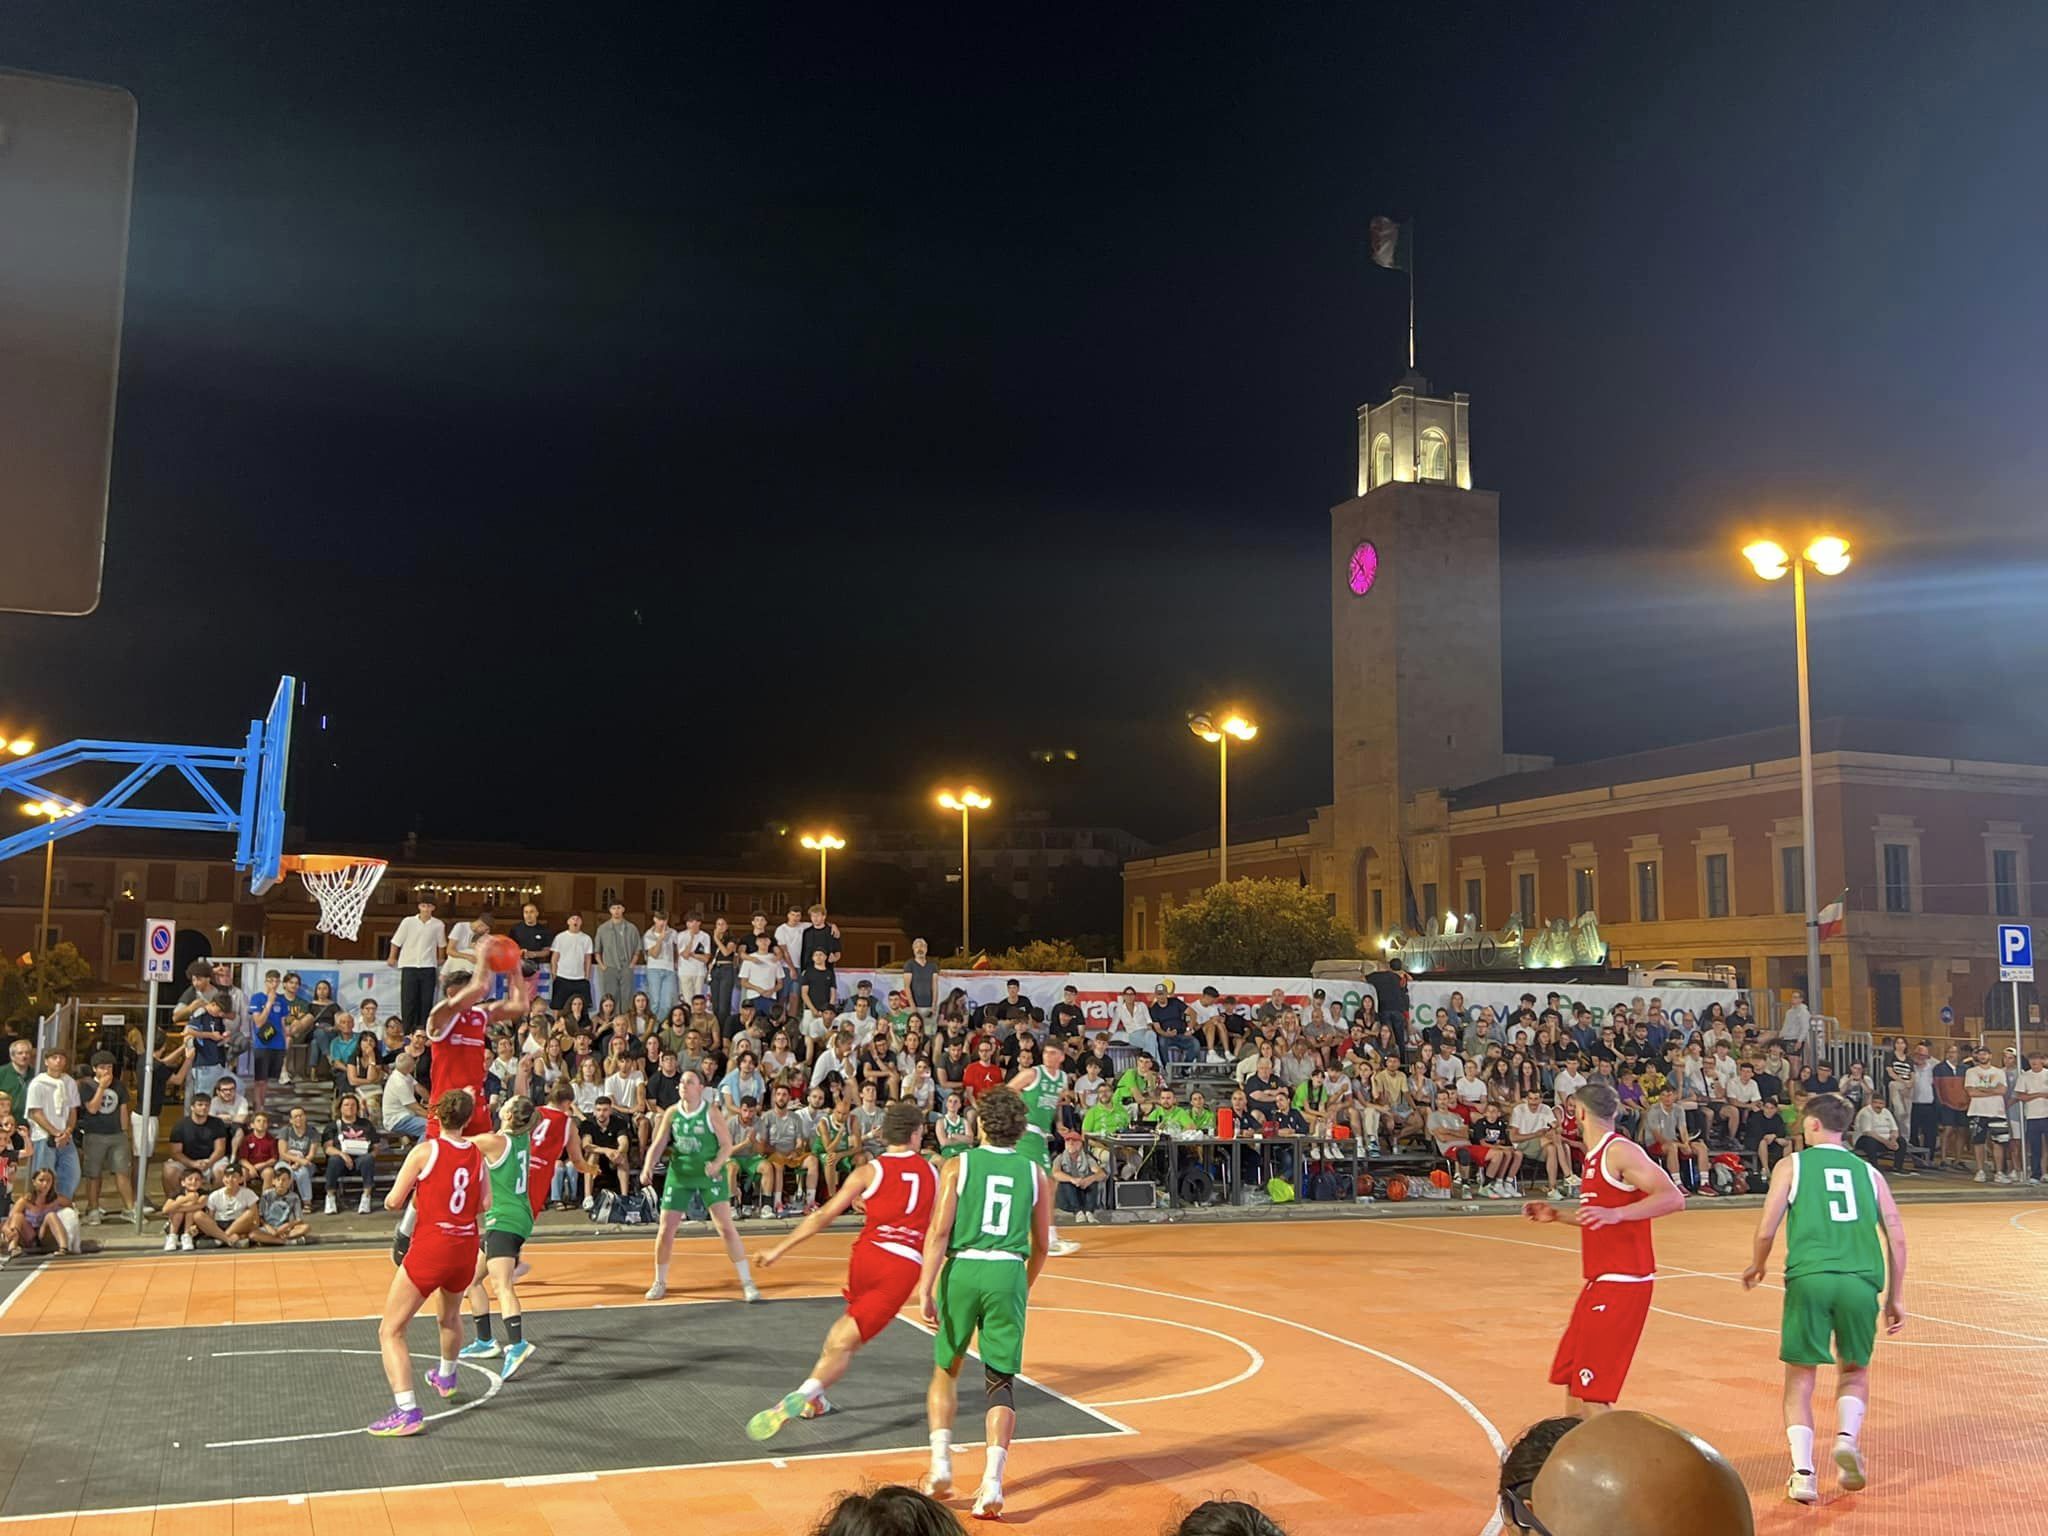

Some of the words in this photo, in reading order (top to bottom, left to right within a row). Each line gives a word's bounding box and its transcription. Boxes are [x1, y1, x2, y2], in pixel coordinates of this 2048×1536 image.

[2005, 929, 2025, 962] P
[532, 1118, 551, 1147] 4
[449, 1167, 470, 1215] 8
[514, 1150, 528, 1195] 3
[901, 1172, 920, 1215] 7
[1823, 1168, 1858, 1222] 9
[981, 1174, 1014, 1237] 6
